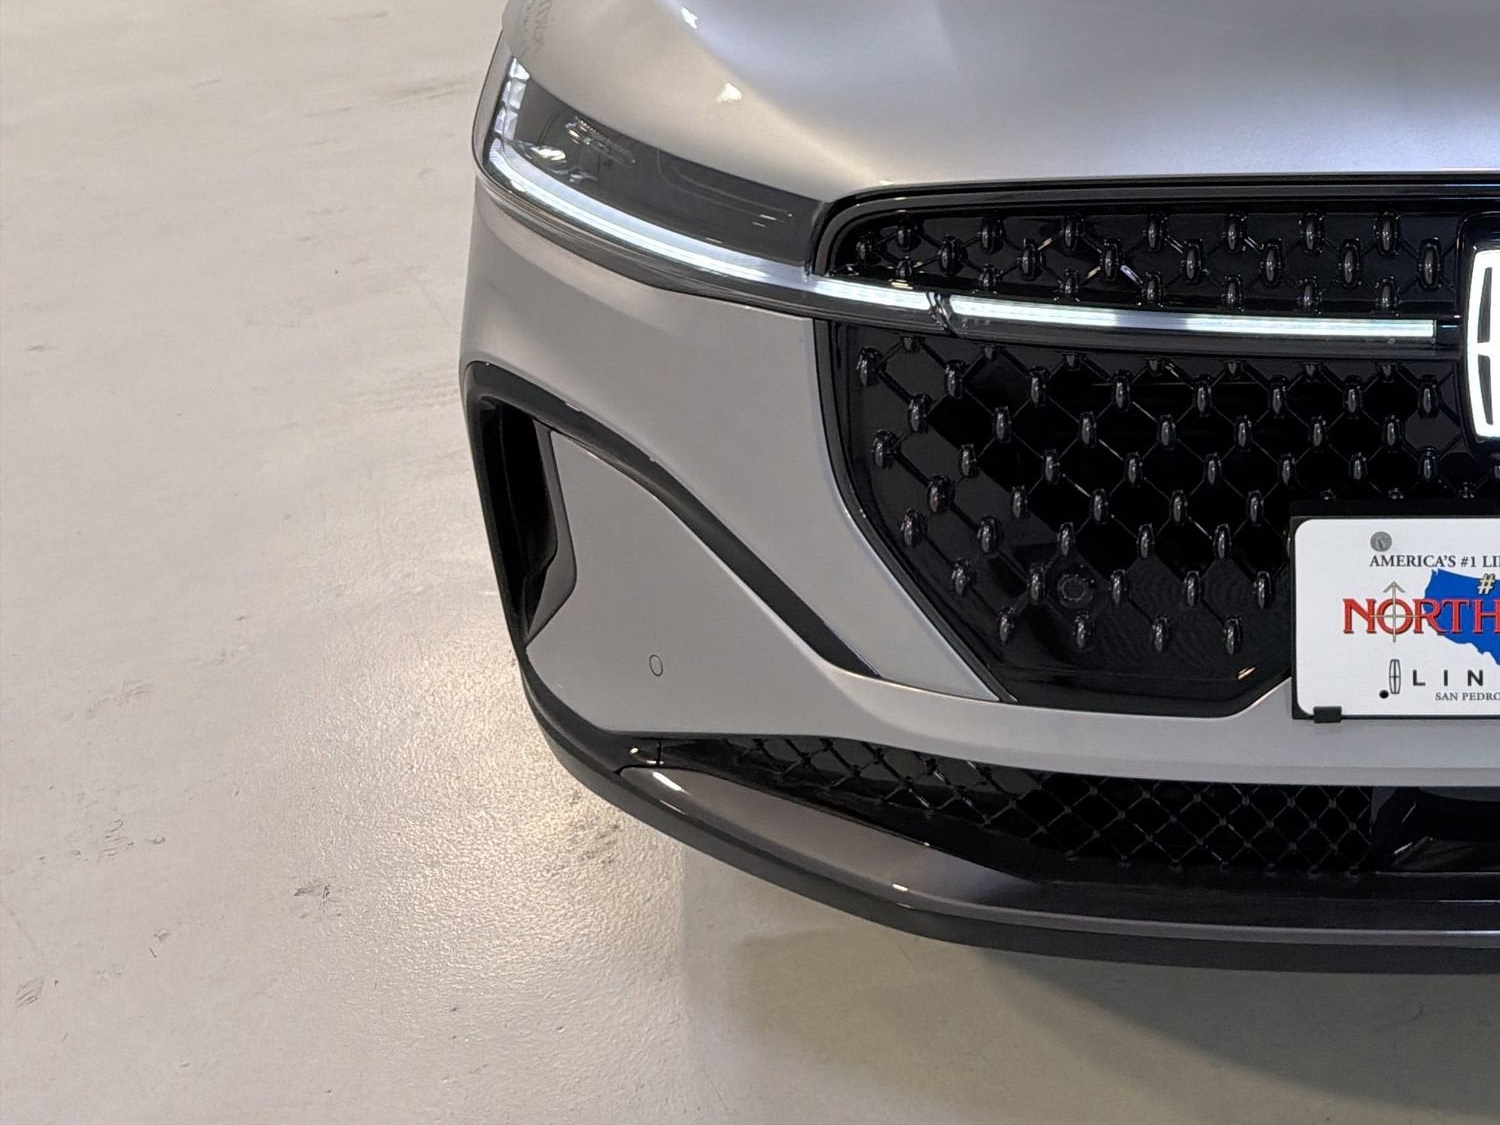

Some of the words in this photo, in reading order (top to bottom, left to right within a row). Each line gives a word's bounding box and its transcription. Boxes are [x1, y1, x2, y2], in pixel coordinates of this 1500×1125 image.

[1369, 554, 1457, 569] AMERICA'S
[1460, 555, 1477, 568] #1
[1435, 692, 1459, 701] SAN
